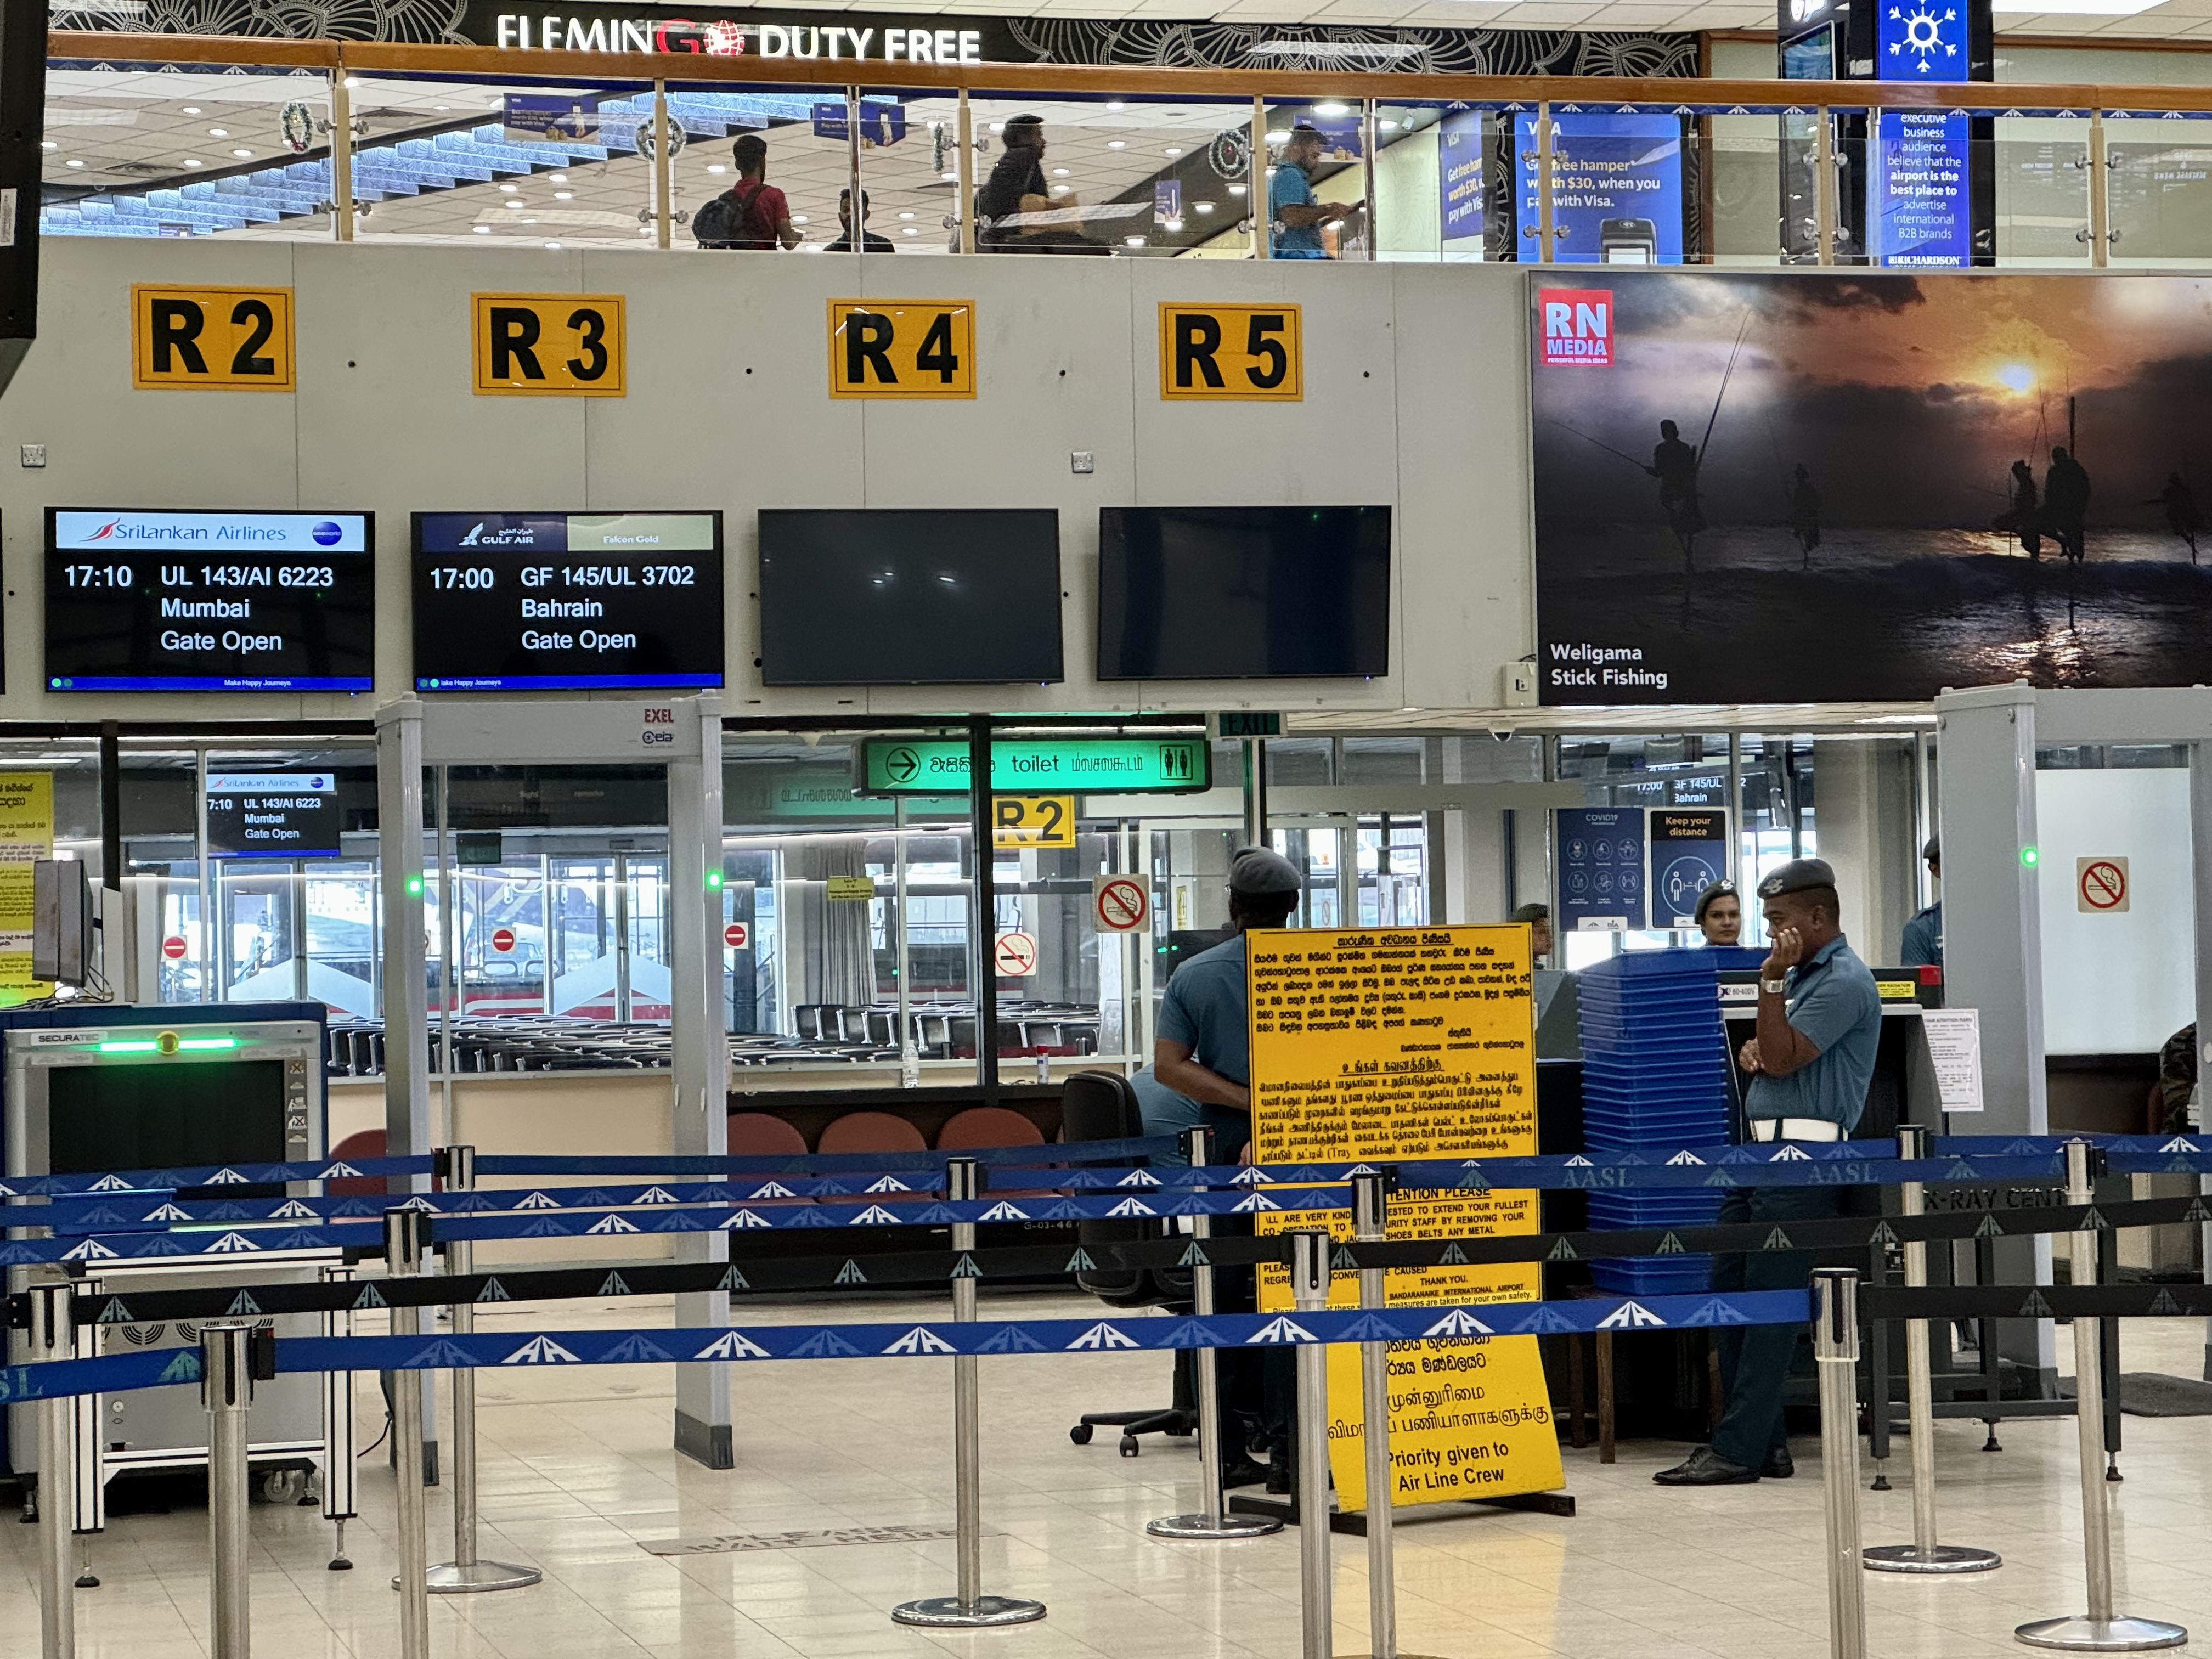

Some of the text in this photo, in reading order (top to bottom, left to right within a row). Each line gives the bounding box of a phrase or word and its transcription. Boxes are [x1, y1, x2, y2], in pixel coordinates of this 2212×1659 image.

[759, 25, 873, 59] DUTY
[884, 29, 980, 63] FREE
[1901, 114, 1946, 123] executive
[1904, 126, 1944, 138] business
[1903, 140, 1946, 152] audience
[1888, 155, 1961, 167] believe that the
[1448, 163, 1470, 182] Get free
[1891, 170, 1959, 182] airport is the
[1567, 177, 1660, 191] $30, when you
[1891, 184, 1957, 197] best place to
[1448, 184, 1465, 201] worth
[1553, 195, 1615, 206] with Visa.
[1904, 200, 1946, 210] advertise
[1448, 202, 1472, 224] pay with
[1894, 214, 1954, 224] international
[1899, 228, 1952, 239] B2B brands
[1898, 256, 1962, 266] RICHARDSON
[1546, 303, 1606, 337] RN
[151, 298, 275, 375] R 2
[490, 307, 608, 381] R 3
[846, 313, 958, 383] R 4
[1547, 339, 1607, 355] MEDIA
[1176, 314, 1287, 389] R 5
[116, 524, 286, 541] SriLankan Airlines
[603, 535, 658, 543] Falcon Gold
[482, 536, 533, 544] GULF AIR
[64, 565, 132, 588] 17:10
[161, 566, 333, 587] UL 143/AI 6223
[430, 568, 494, 589] 17:00
[521, 566, 694, 586] GF 145/UL 3702
[161, 597, 250, 618] Mumbai
[522, 599, 602, 617] Bahrain
[161, 631, 282, 654] Gate Open
[521, 630, 636, 652] Gate Open
[1550, 644, 1642, 664] Weligama
[244, 679, 262, 687] Happy
[263, 679, 291, 687] Journeys
[454, 679, 473, 687] Happy
[1551, 669, 1667, 689] Stick Fishing
[644, 709, 674, 723] EXEL
[1012, 755, 1059, 772] toilet
[224, 779, 299, 787] SriLankan Airlines
[1690, 778, 1722, 788] 145/UL
[208, 799, 232, 810] 7:10
[244, 798, 321, 809] UL 143/AI 6223
[1675, 793, 1707, 803] Bahrain
[245, 813, 284, 823] Mumbai
[1666, 816, 1711, 826] Keep your
[245, 829, 300, 840] Gate Open
[1669, 828, 1707, 836] distance
[38, 1034, 99, 1042] SECURATEC
[1561, 1167, 1635, 1188] AASL
[1808, 1162, 1879, 1185] AASL
[1444, 1188, 1491, 1198] PLEASE
[1924, 1189, 1997, 1211] X-RAY
[1418, 1200, 1528, 1215] TO EXTEND YOUR FULLEST
[1284, 1212, 1327, 1223] ARE VERY
[1412, 1212, 1524, 1227] STAFF BY REMOVING YOUR
[1335, 1223, 1346, 1232] TO
[1386, 1226, 1495, 1240] SHOES BELTS ANY METAL
[1395, 1266, 1427, 1275] CAUSED
[1420, 1276, 1468, 1286] THANK YOU.
[1390, 1284, 1524, 1300] BANDARANAIKE INTERNATIONAL AIRPORT
[1389, 1299, 1424, 1308] measures
[1440, 1296, 1459, 1305] taken
[1462, 1294, 1471, 1304] for
[1474, 1295, 1489, 1305] your
[1492, 1293, 1506, 1301] own
[1509, 1291, 1532, 1301] safety.
[1390, 1441, 1509, 1468] Priority given to
[1399, 1468, 1504, 1492] Air Line Crew
[685, 1530, 957, 1551] WAIT HERE
[714, 1526, 913, 1542] PLEASE
